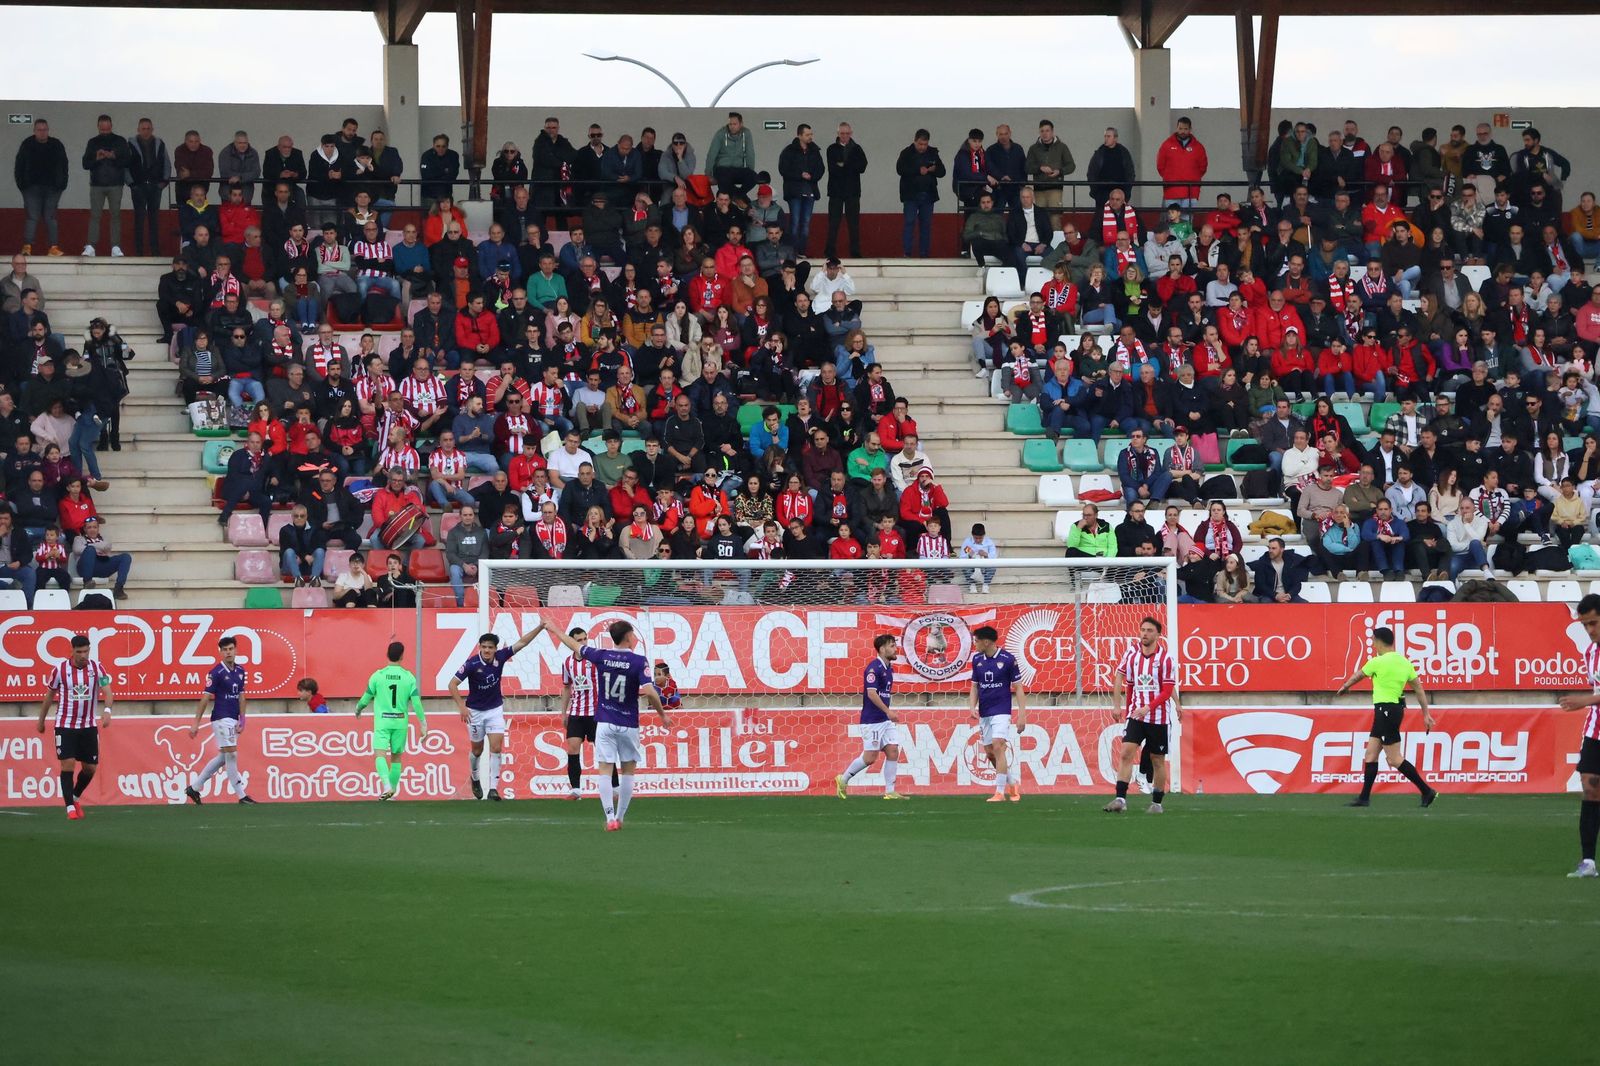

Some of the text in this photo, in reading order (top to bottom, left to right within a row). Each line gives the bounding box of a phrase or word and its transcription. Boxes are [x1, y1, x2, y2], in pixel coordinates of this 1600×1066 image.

[717, 544, 734, 557] 80
[752, 611, 858, 689] CF
[1182, 627, 1312, 661] ÓPTICO
[603, 659, 631, 670] TAVARES
[138, 673, 147, 684] Y
[602, 671, 627, 703] 14
[1534, 675, 1583, 685] PODOLOGÍA
[389, 684, 397, 709] 1
[261, 727, 455, 757] Escula
